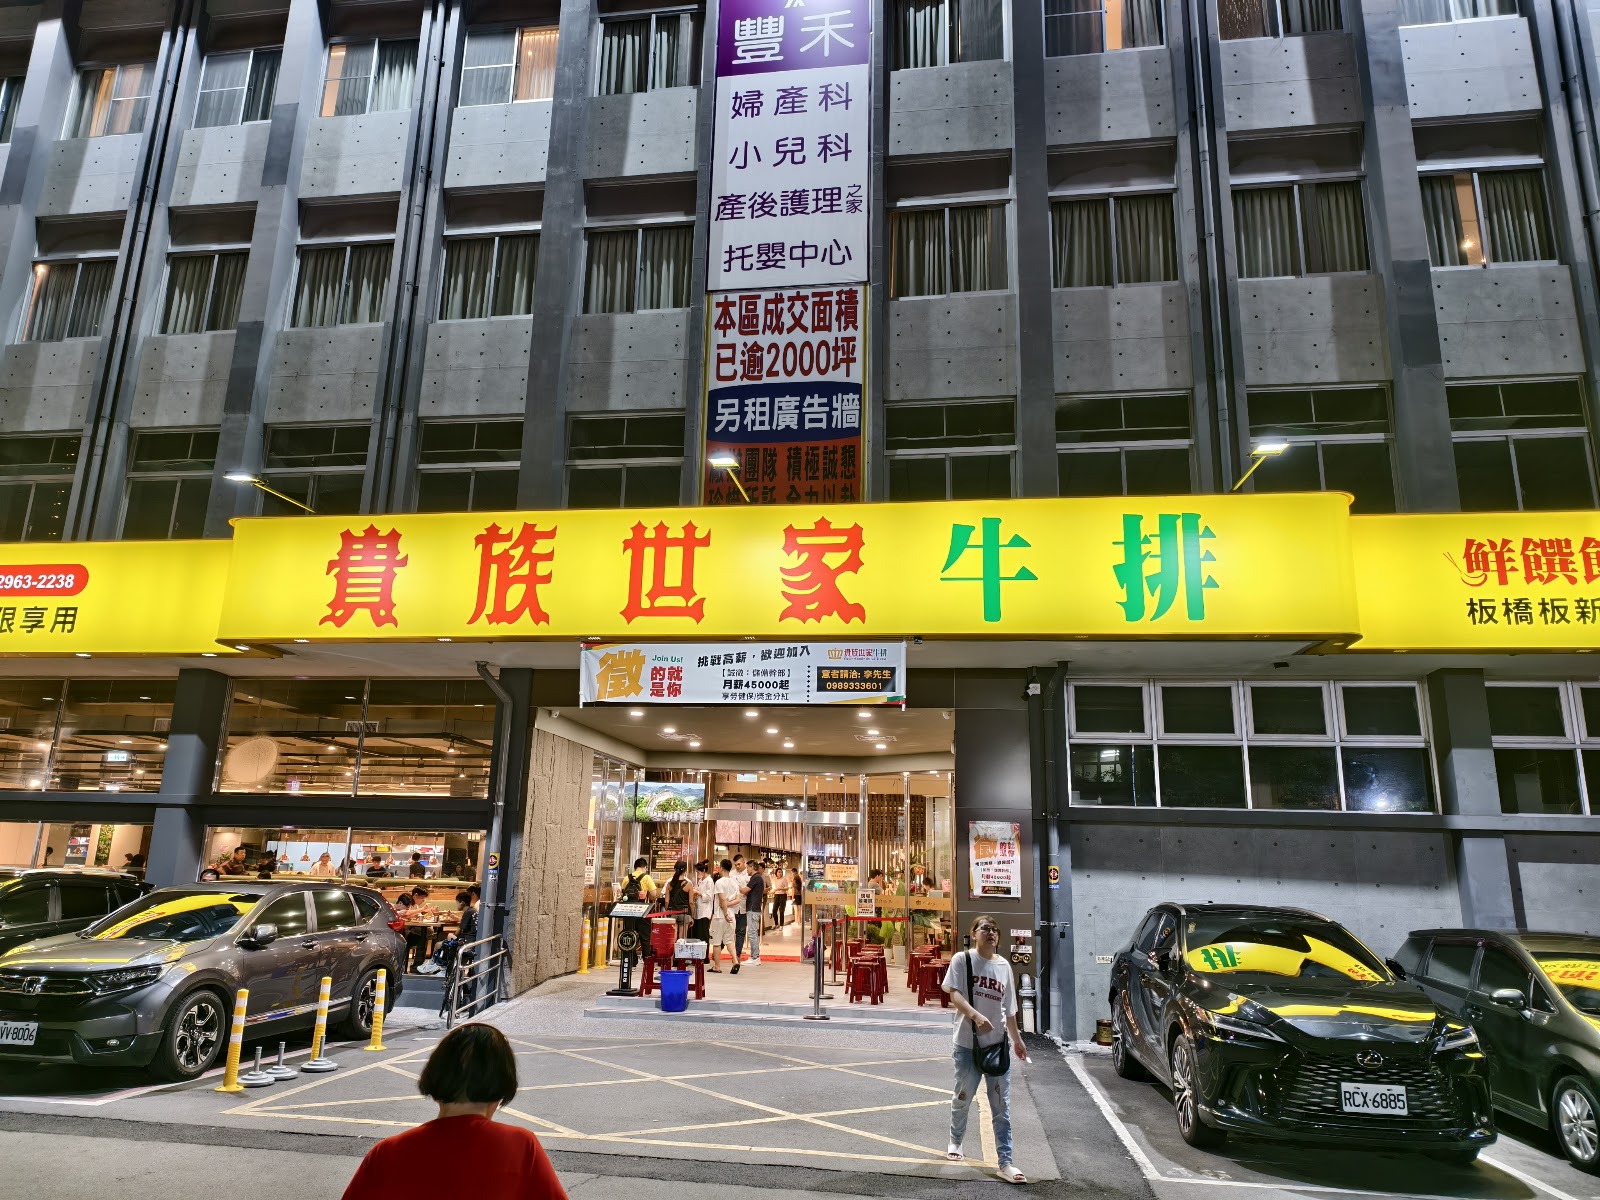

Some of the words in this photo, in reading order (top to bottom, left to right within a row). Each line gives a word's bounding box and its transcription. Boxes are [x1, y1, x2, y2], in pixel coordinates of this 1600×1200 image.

[732, 10, 854, 64] 豐禾
[731, 82, 852, 119] 婦產科
[729, 133, 852, 169] 小兒科
[715, 187, 842, 221] 產後護理
[846, 184, 863, 214] 之家
[723, 239, 852, 272] 托嬰中心
[714, 288, 859, 337] 本區成交面積
[715, 336, 857, 382] 已逾2000坪
[714, 393, 860, 433] 另租廣告牆
[709, 448, 777, 484] 團隊
[319, 512, 1219, 628] 貴族世家牛排
[1466, 597, 1600, 625] 板橋板新
[596, 649, 647, 700] 徵
[722, 680, 790, 690] 月薪45000起
[826, 682, 882, 690] 0989333601
[863, 670, 892, 679] 李先生
